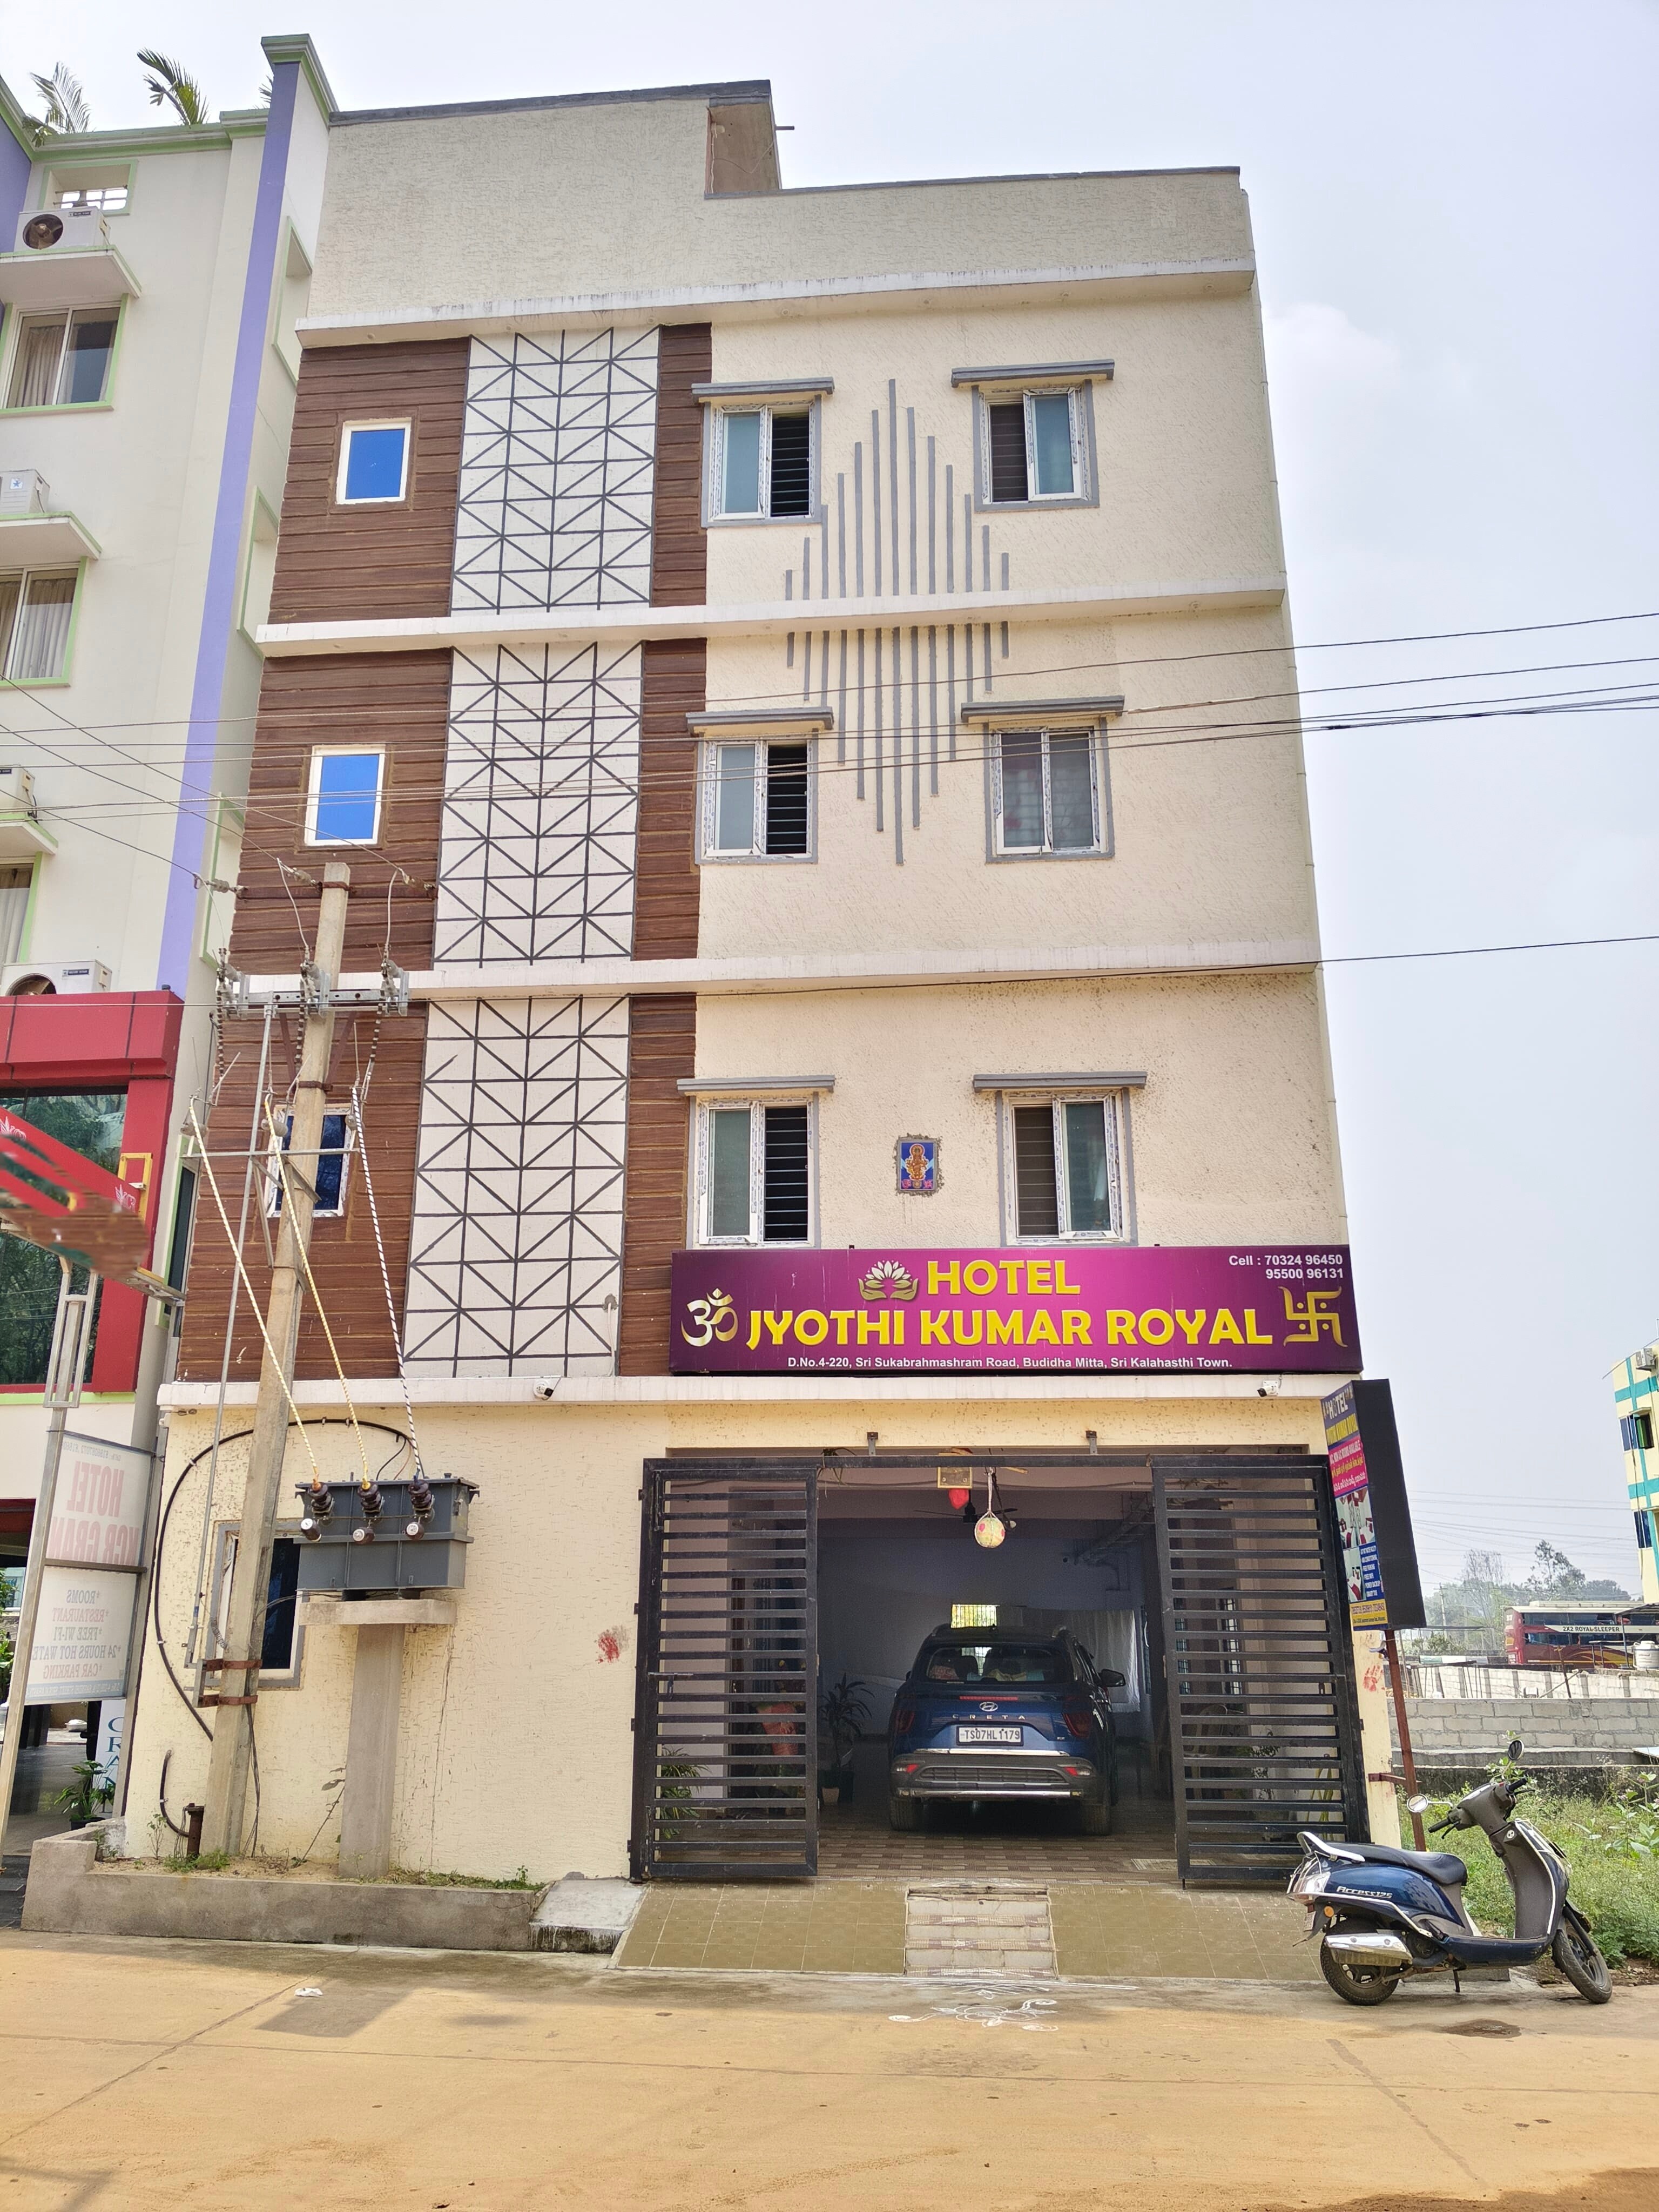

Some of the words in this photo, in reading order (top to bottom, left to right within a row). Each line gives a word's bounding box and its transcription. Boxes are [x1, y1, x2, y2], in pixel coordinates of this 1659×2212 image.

[1229, 1255, 1253, 1265] Cell
[1264, 1255, 1303, 1265] 70324
[1305, 1255, 1343, 1265] 96450
[928, 1260, 1081, 1295] HOTEL
[1265, 1269, 1303, 1279] 95500
[1306, 1268, 1344, 1279] 96131
[746, 1311, 905, 1350] JYOTHI
[921, 1310, 1092, 1345] KUMAR
[1107, 1309, 1273, 1345] ROYAL
[788, 1357, 852, 1369] D.No.4-220,
[855, 1357, 871, 1367] Sri
[874, 1357, 982, 1367] Sukabrahmashram
[986, 1357, 1020, 1369] Road,
[1023, 1357, 1072, 1367] Budidha
[1075, 1357, 1107, 1369] Mitta,
[1110, 1357, 1127, 1367] Sri
[1130, 1357, 1193, 1367] Kalahasthi
[1196, 1357, 1232, 1367] Town.
[1328, 1391, 1348, 1420] HOTEL
[964, 1729, 1021, 1741] TS07HL1179
